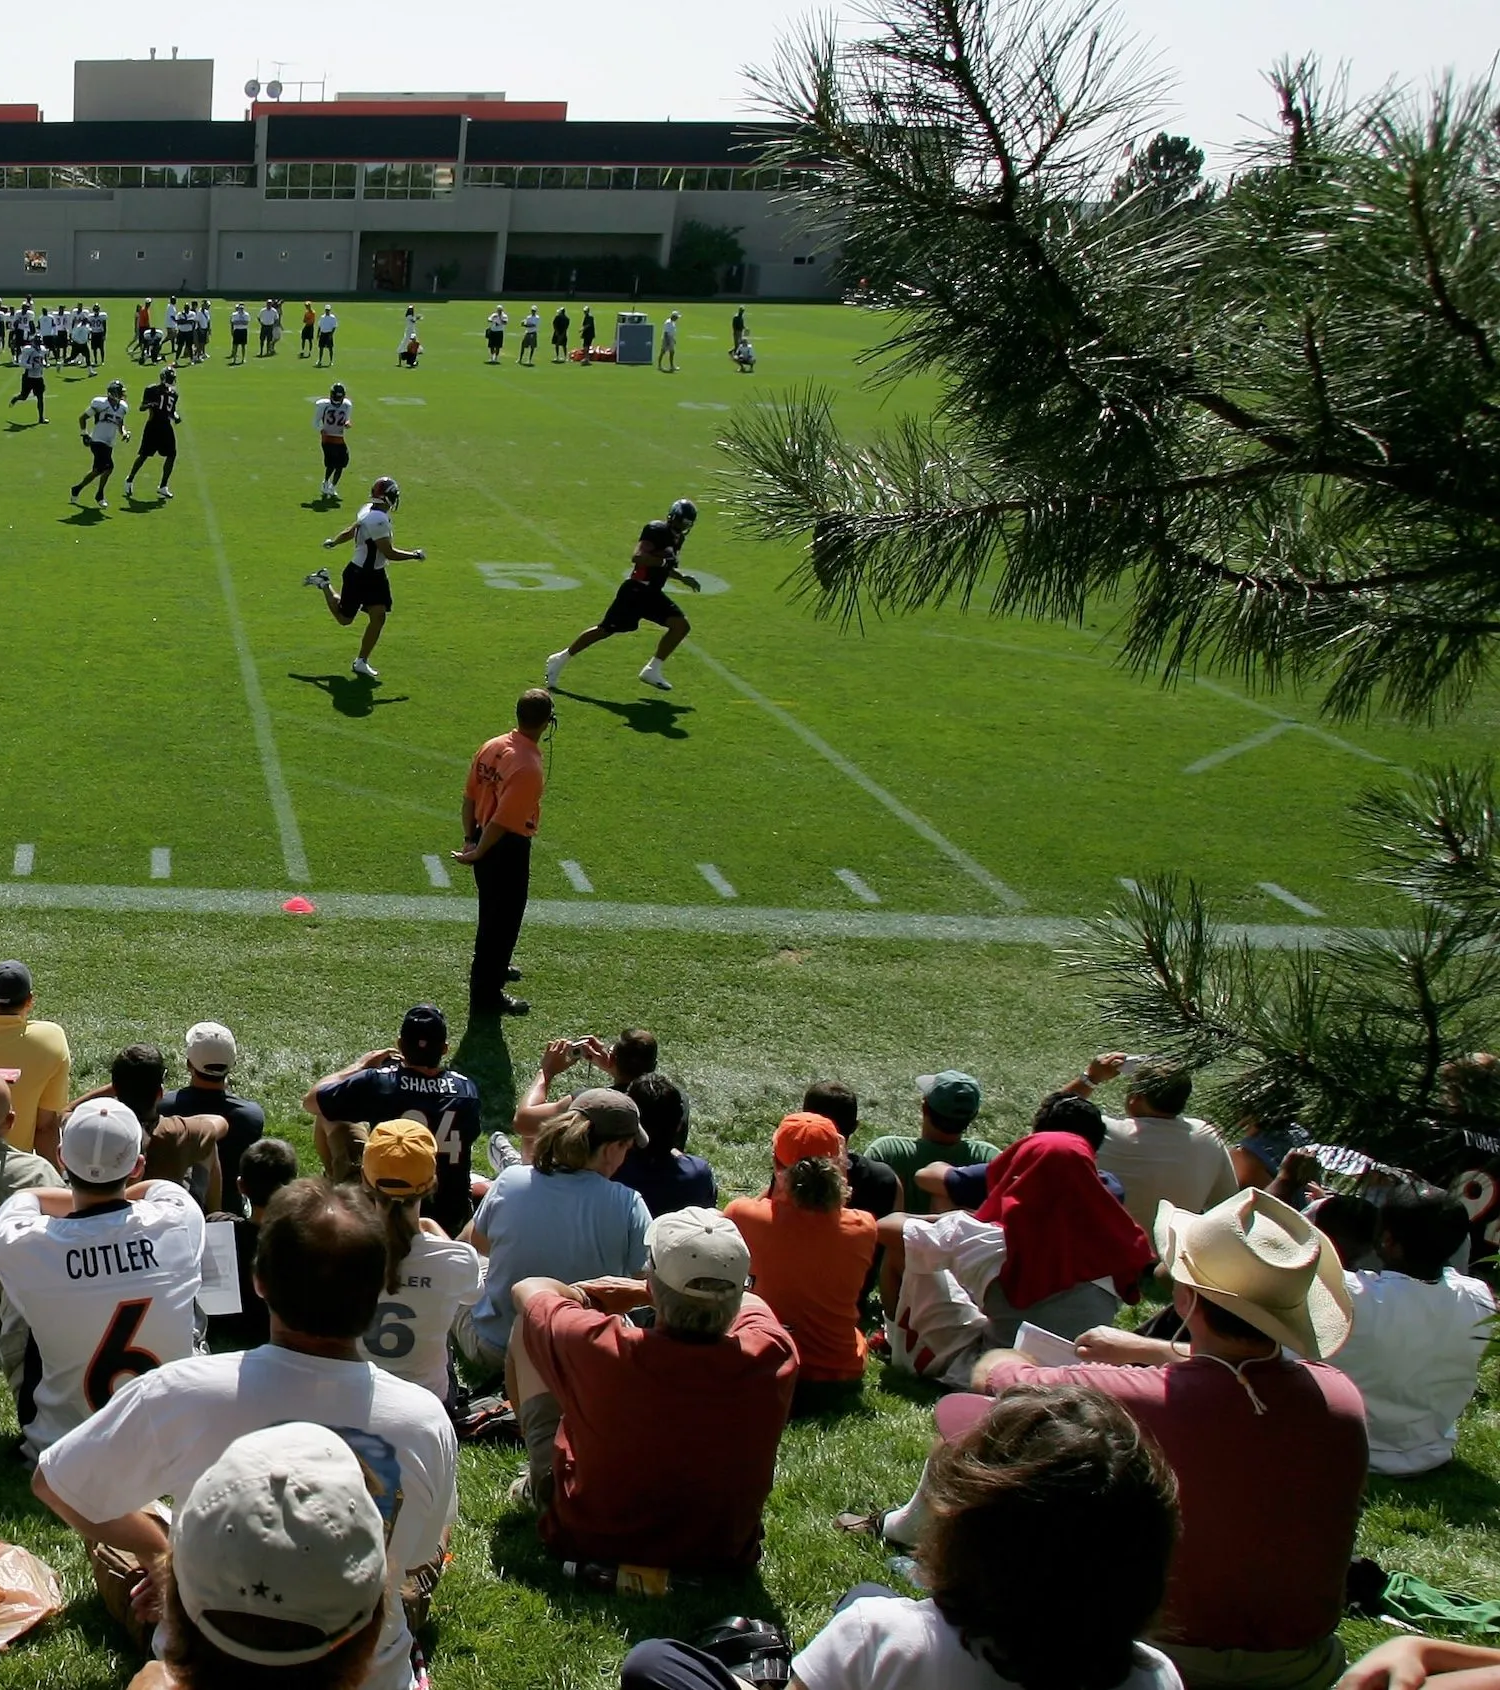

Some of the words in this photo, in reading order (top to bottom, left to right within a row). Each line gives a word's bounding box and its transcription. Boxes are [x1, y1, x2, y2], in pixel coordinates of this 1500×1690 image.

[159, 395, 175, 412] 15
[326, 410, 346, 426] 32
[400, 1076, 458, 1094] SHARPE
[66, 1239, 160, 1280] CUTLER
[362, 1302, 417, 1358] 6
[83, 1296, 163, 1414] 6
